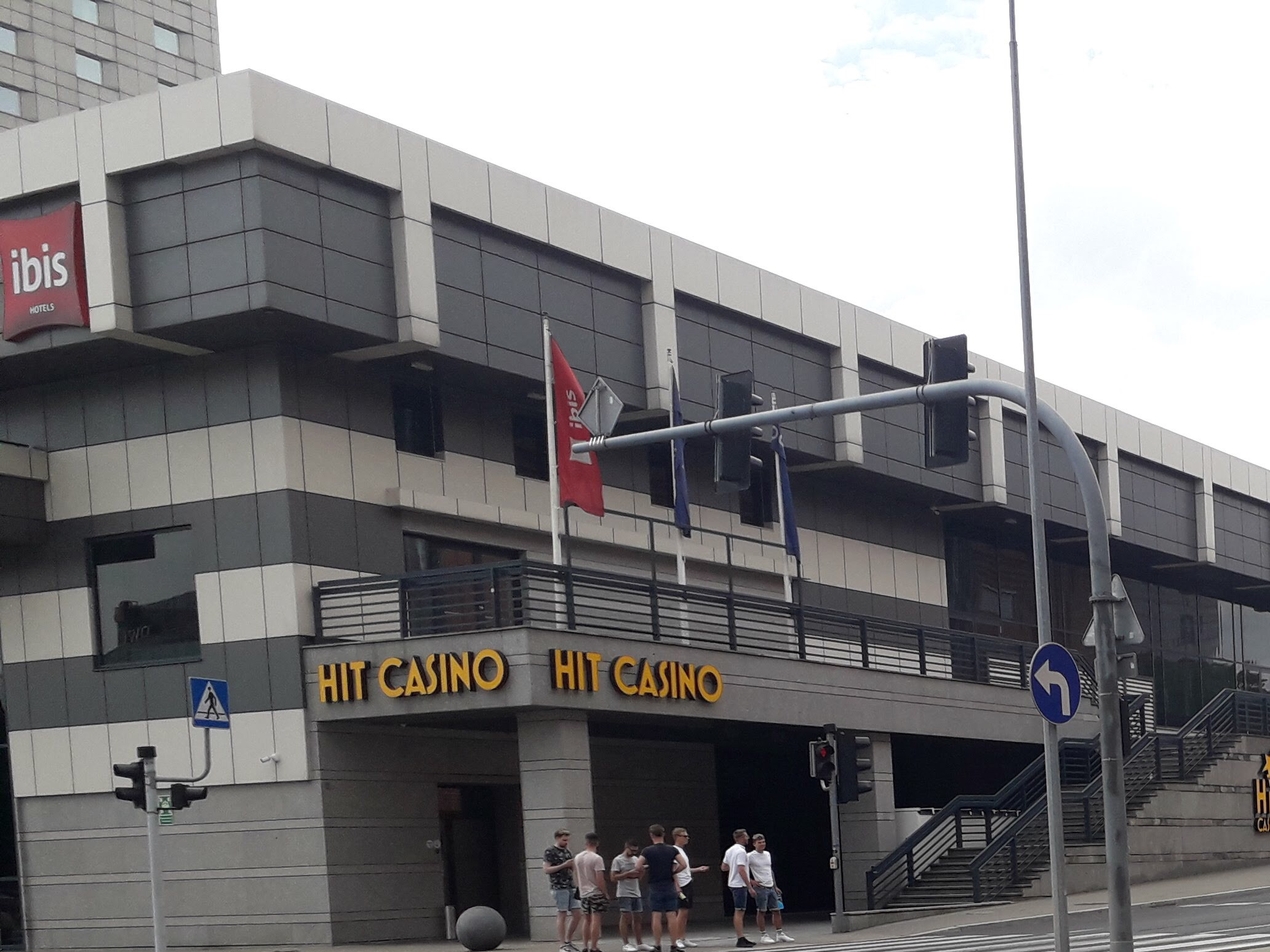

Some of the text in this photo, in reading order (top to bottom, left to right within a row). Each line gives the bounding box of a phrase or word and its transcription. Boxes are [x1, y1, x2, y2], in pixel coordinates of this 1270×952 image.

[10, 243, 69, 295] ibis
[29, 303, 55, 314] HOTELS
[317, 648, 507, 703] HIT CASINO
[551, 648, 724, 704] HIT CASINO
